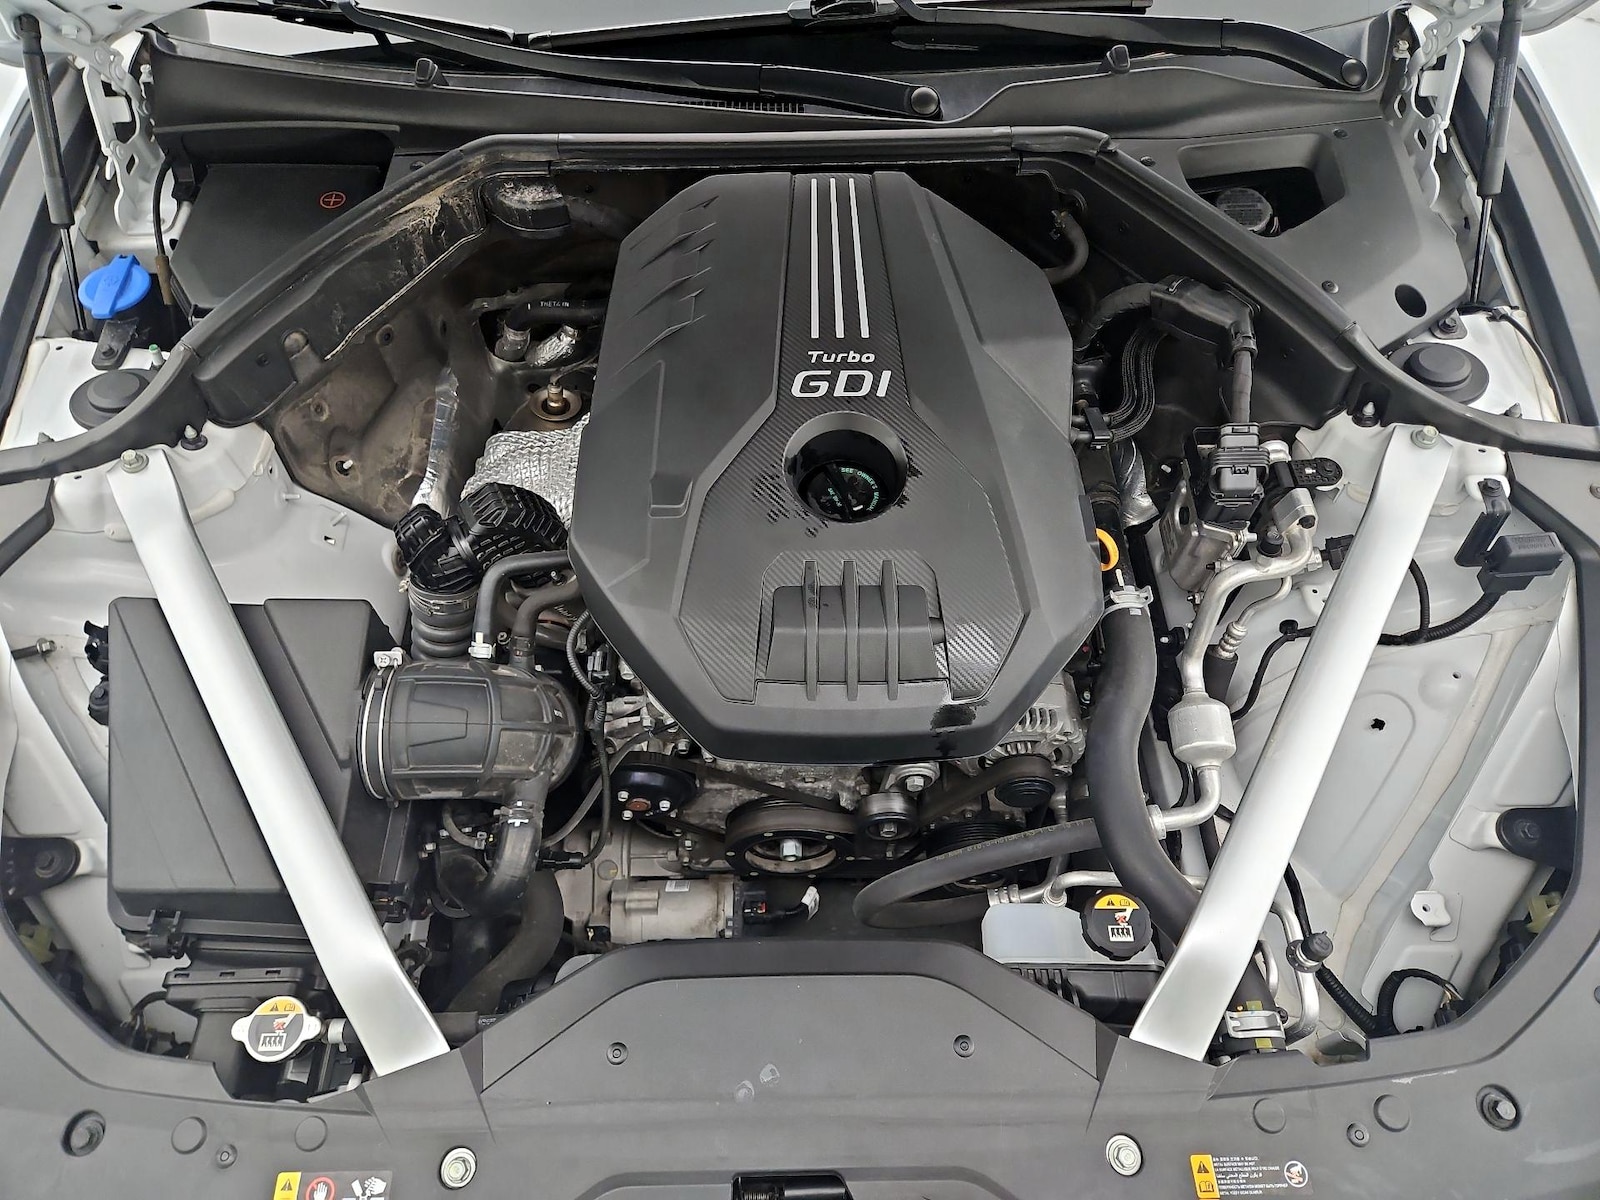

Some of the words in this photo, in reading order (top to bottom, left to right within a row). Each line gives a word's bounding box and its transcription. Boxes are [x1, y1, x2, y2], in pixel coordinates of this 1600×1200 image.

[808, 350, 876, 363] Turbo
[791, 370, 892, 398] GDI
[857, 470, 878, 490] OWNER'S
[866, 491, 880, 512] MANUAL
